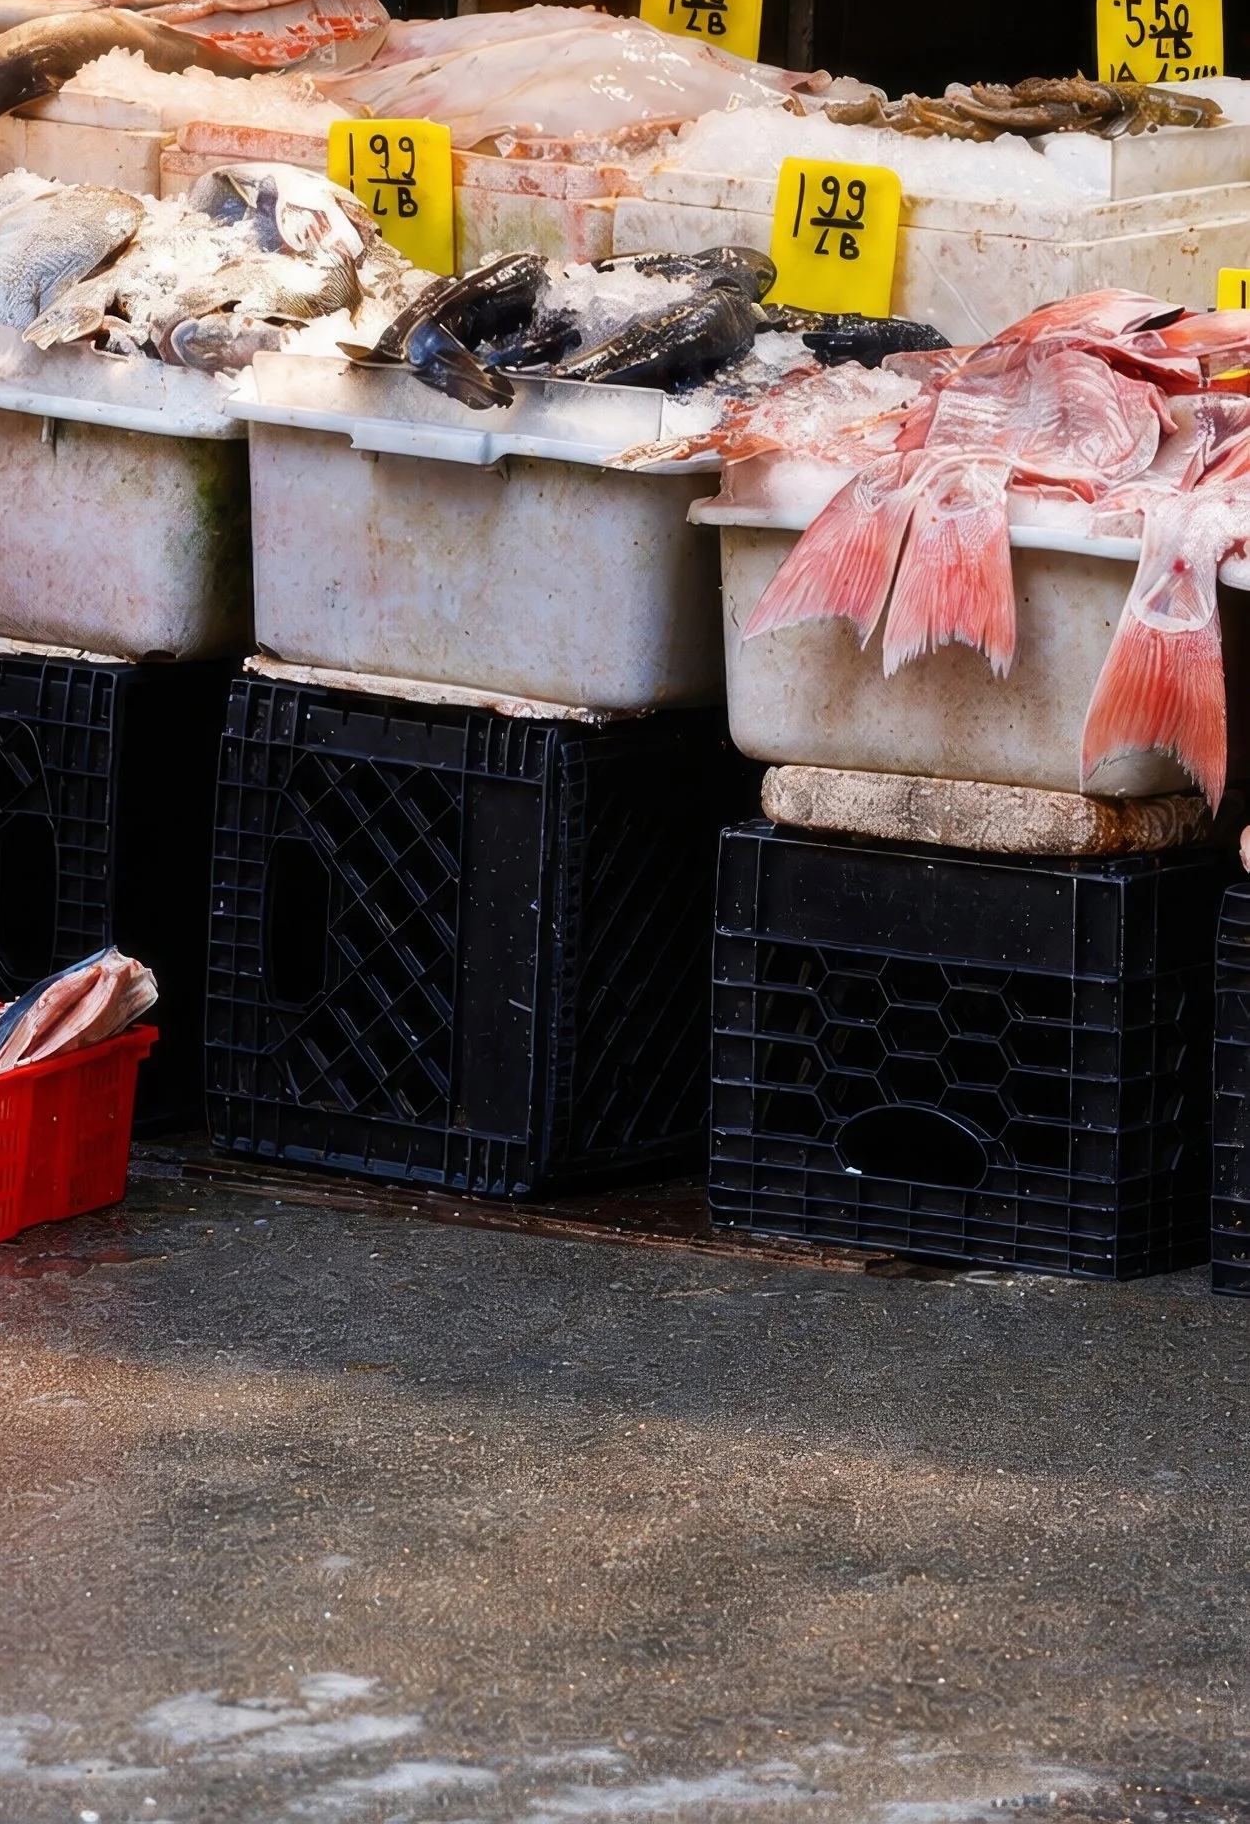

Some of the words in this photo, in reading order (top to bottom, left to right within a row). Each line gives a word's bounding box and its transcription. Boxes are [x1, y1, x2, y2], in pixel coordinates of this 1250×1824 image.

[685, 8, 727, 36] LB
[1155, 38, 1192, 60] LB
[372, 186, 419, 218] LB
[813, 228, 861, 261] LB
